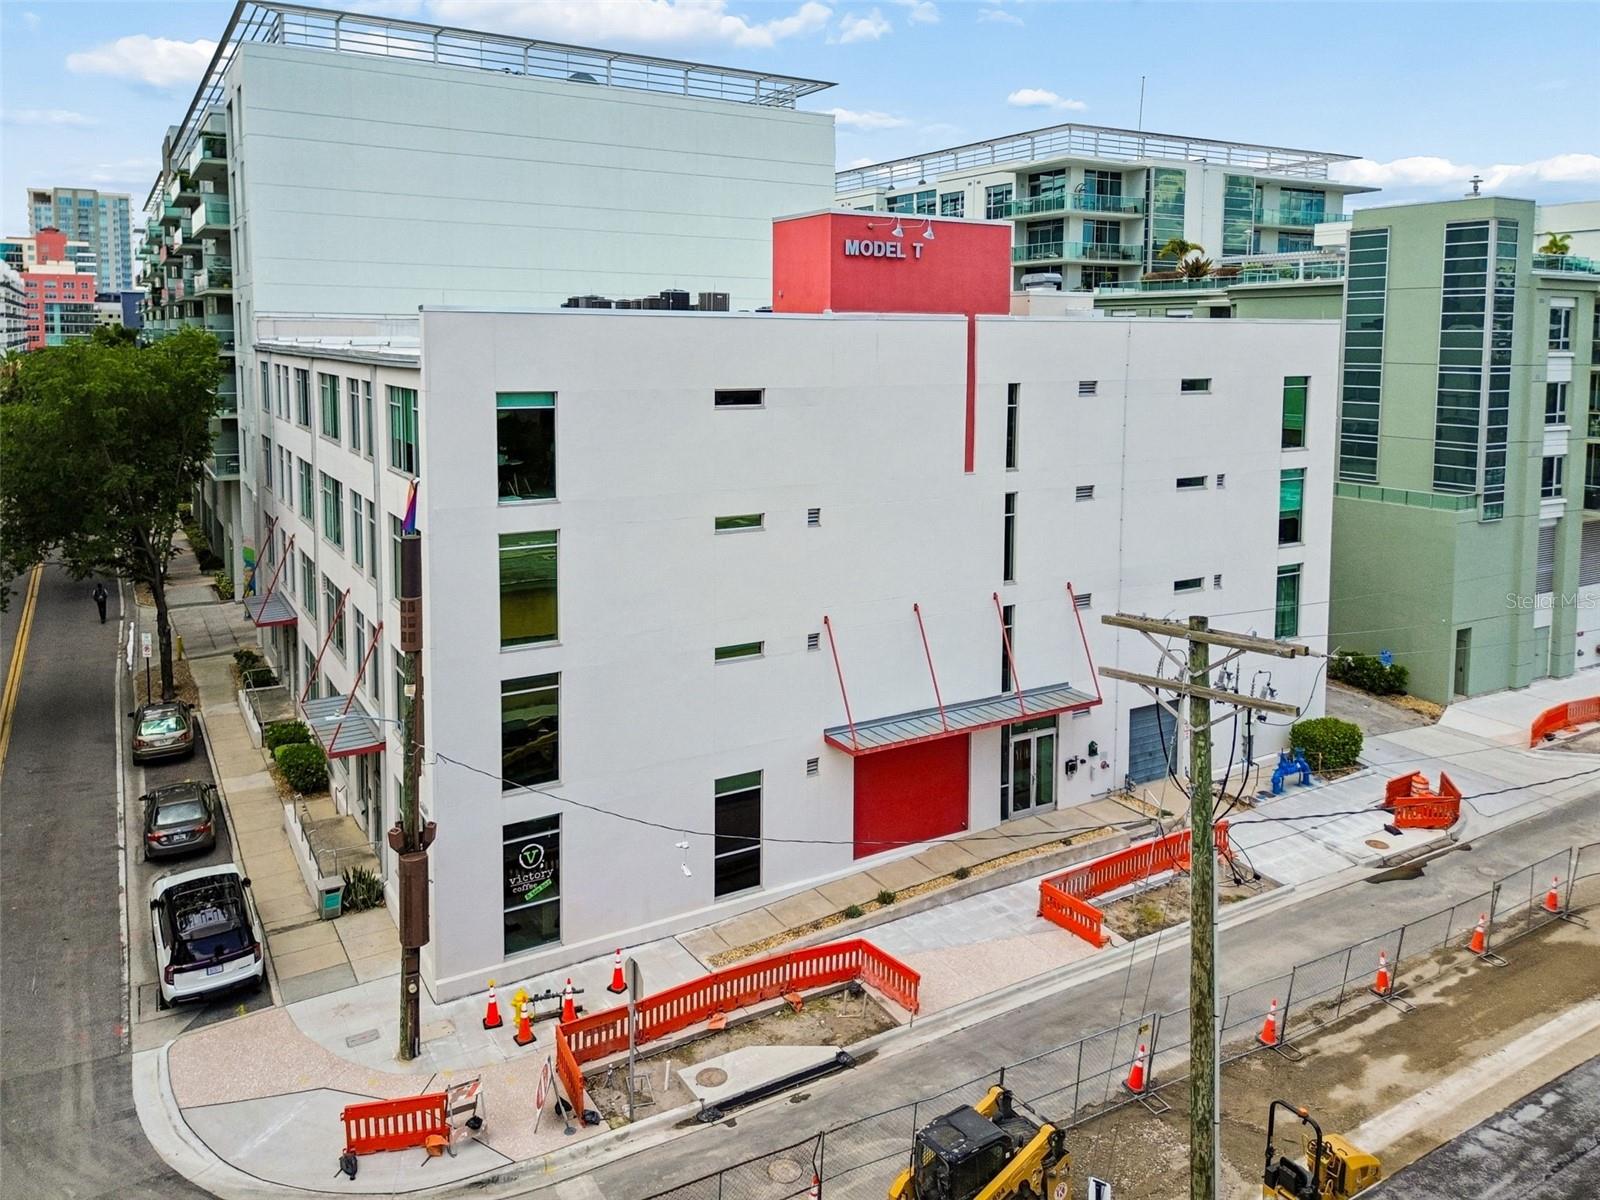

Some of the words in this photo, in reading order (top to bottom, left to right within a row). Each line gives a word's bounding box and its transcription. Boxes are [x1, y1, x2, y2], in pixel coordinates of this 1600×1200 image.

[845, 239, 906, 258] MODEL
[912, 242, 924, 258] T
[523, 849, 539, 864] V
[509, 868, 554, 885] victory
[512, 883, 538, 893] coffee
